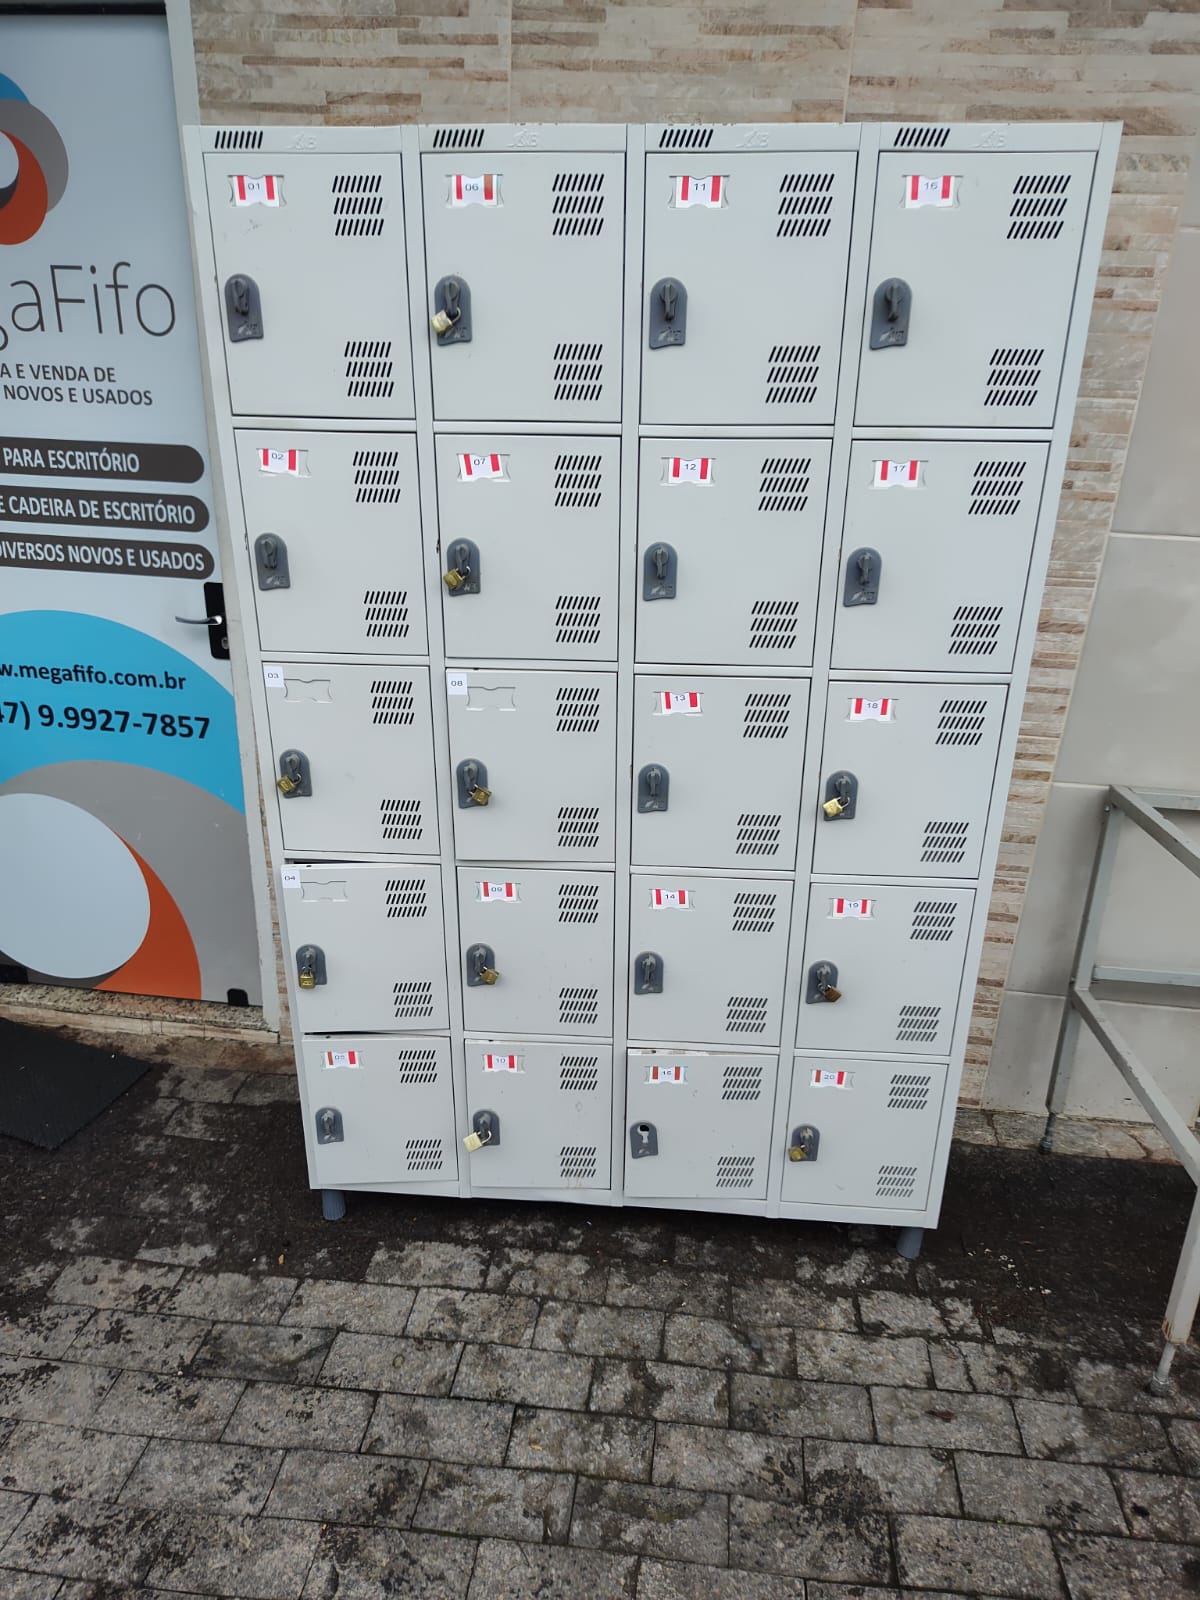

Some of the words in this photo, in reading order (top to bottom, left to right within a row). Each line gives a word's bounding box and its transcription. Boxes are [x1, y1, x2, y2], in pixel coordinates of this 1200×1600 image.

[248, 182, 260, 190] 01
[464, 184, 480, 192] 06
[694, 184, 706, 192] 11
[924, 182, 938, 190] 16
[0, 261, 175, 351] aFifo
[16, 363, 26, 379] E
[29, 364, 89, 382] VENDA
[94, 366, 117, 383] DE
[3, 384, 64, 402] NOVOS
[68, 387, 78, 403] E
[82, 388, 153, 406] USADOS
[3, 447, 46, 468] PARA
[48, 448, 140, 473] ESCRITÓRIO
[272, 452, 284, 460] 02
[474, 458, 486, 466] 07
[686, 464, 696, 472] 12
[894, 464, 906, 472] 17
[9, 496, 76, 518] CADEIRA
[79, 500, 100, 519] DE
[103, 499, 196, 524] ESCRITÓRIO
[68, 545, 123, 566] NOVOS
[127, 548, 137, 567] E
[139, 549, 205, 572] USADOS
[674, 694, 686, 702] 13
[38, 704, 210, 739] 9.9927-7857
